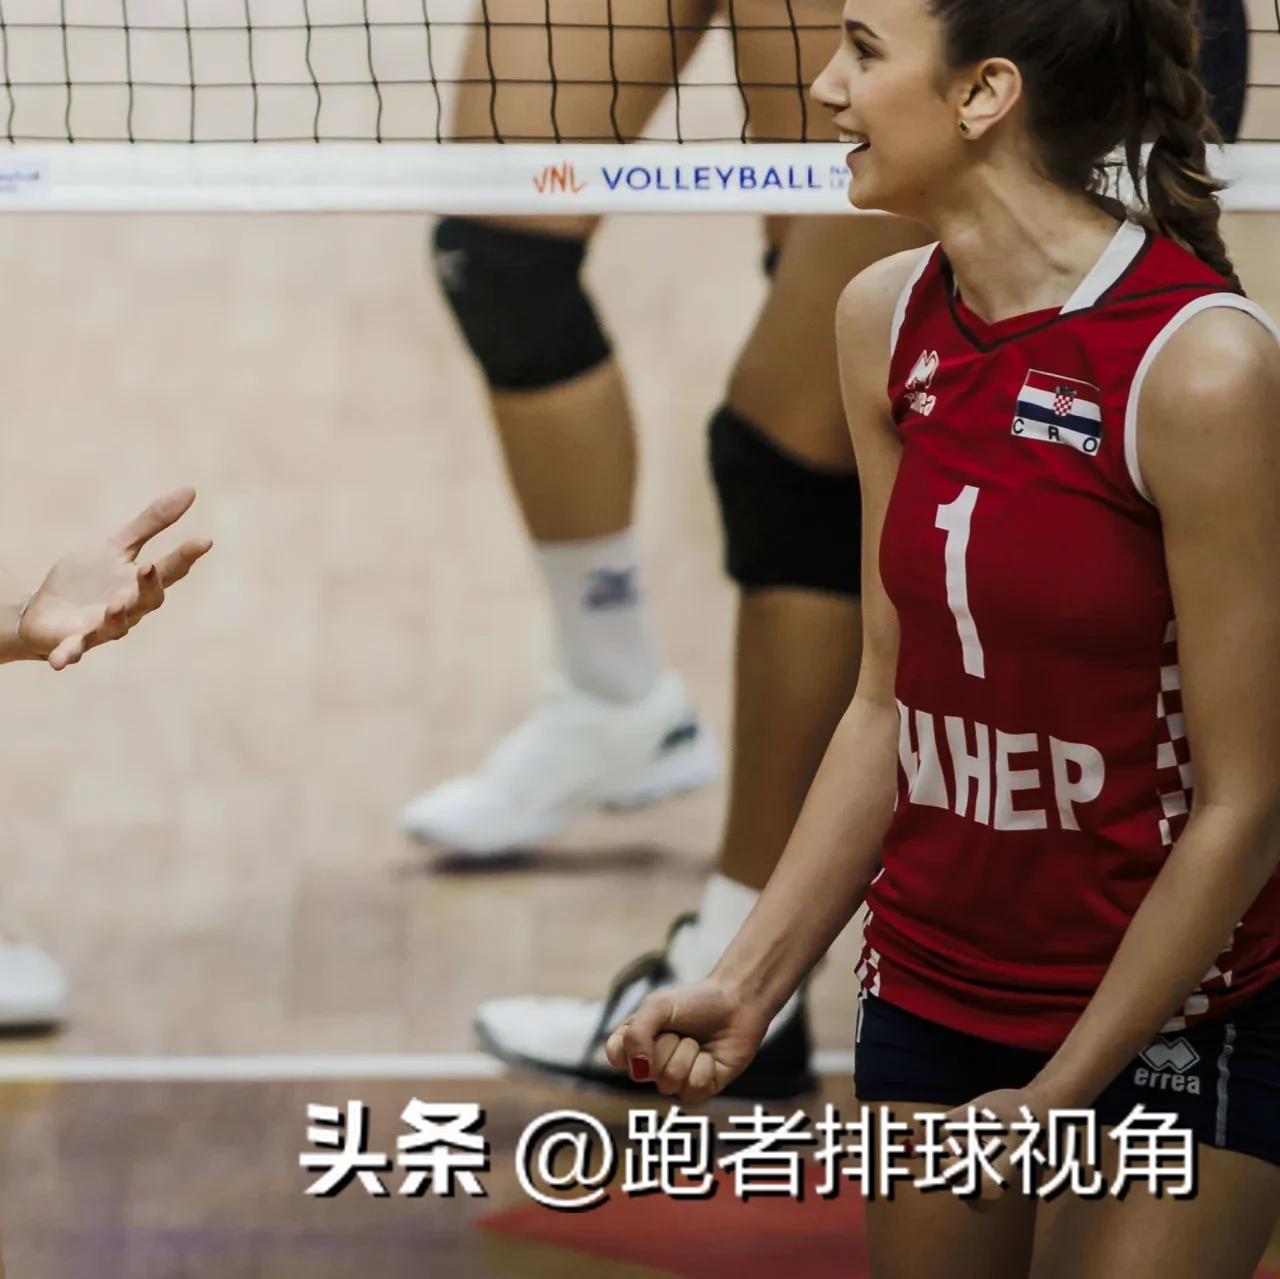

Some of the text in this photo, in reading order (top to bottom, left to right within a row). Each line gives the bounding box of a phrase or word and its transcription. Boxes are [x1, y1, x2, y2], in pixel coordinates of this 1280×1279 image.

[601, 166, 822, 191] VOLLEYBALL
[935, 485, 985, 679] 1
[944, 715, 1106, 832] HEP
[1134, 1067, 1201, 1095] errea
